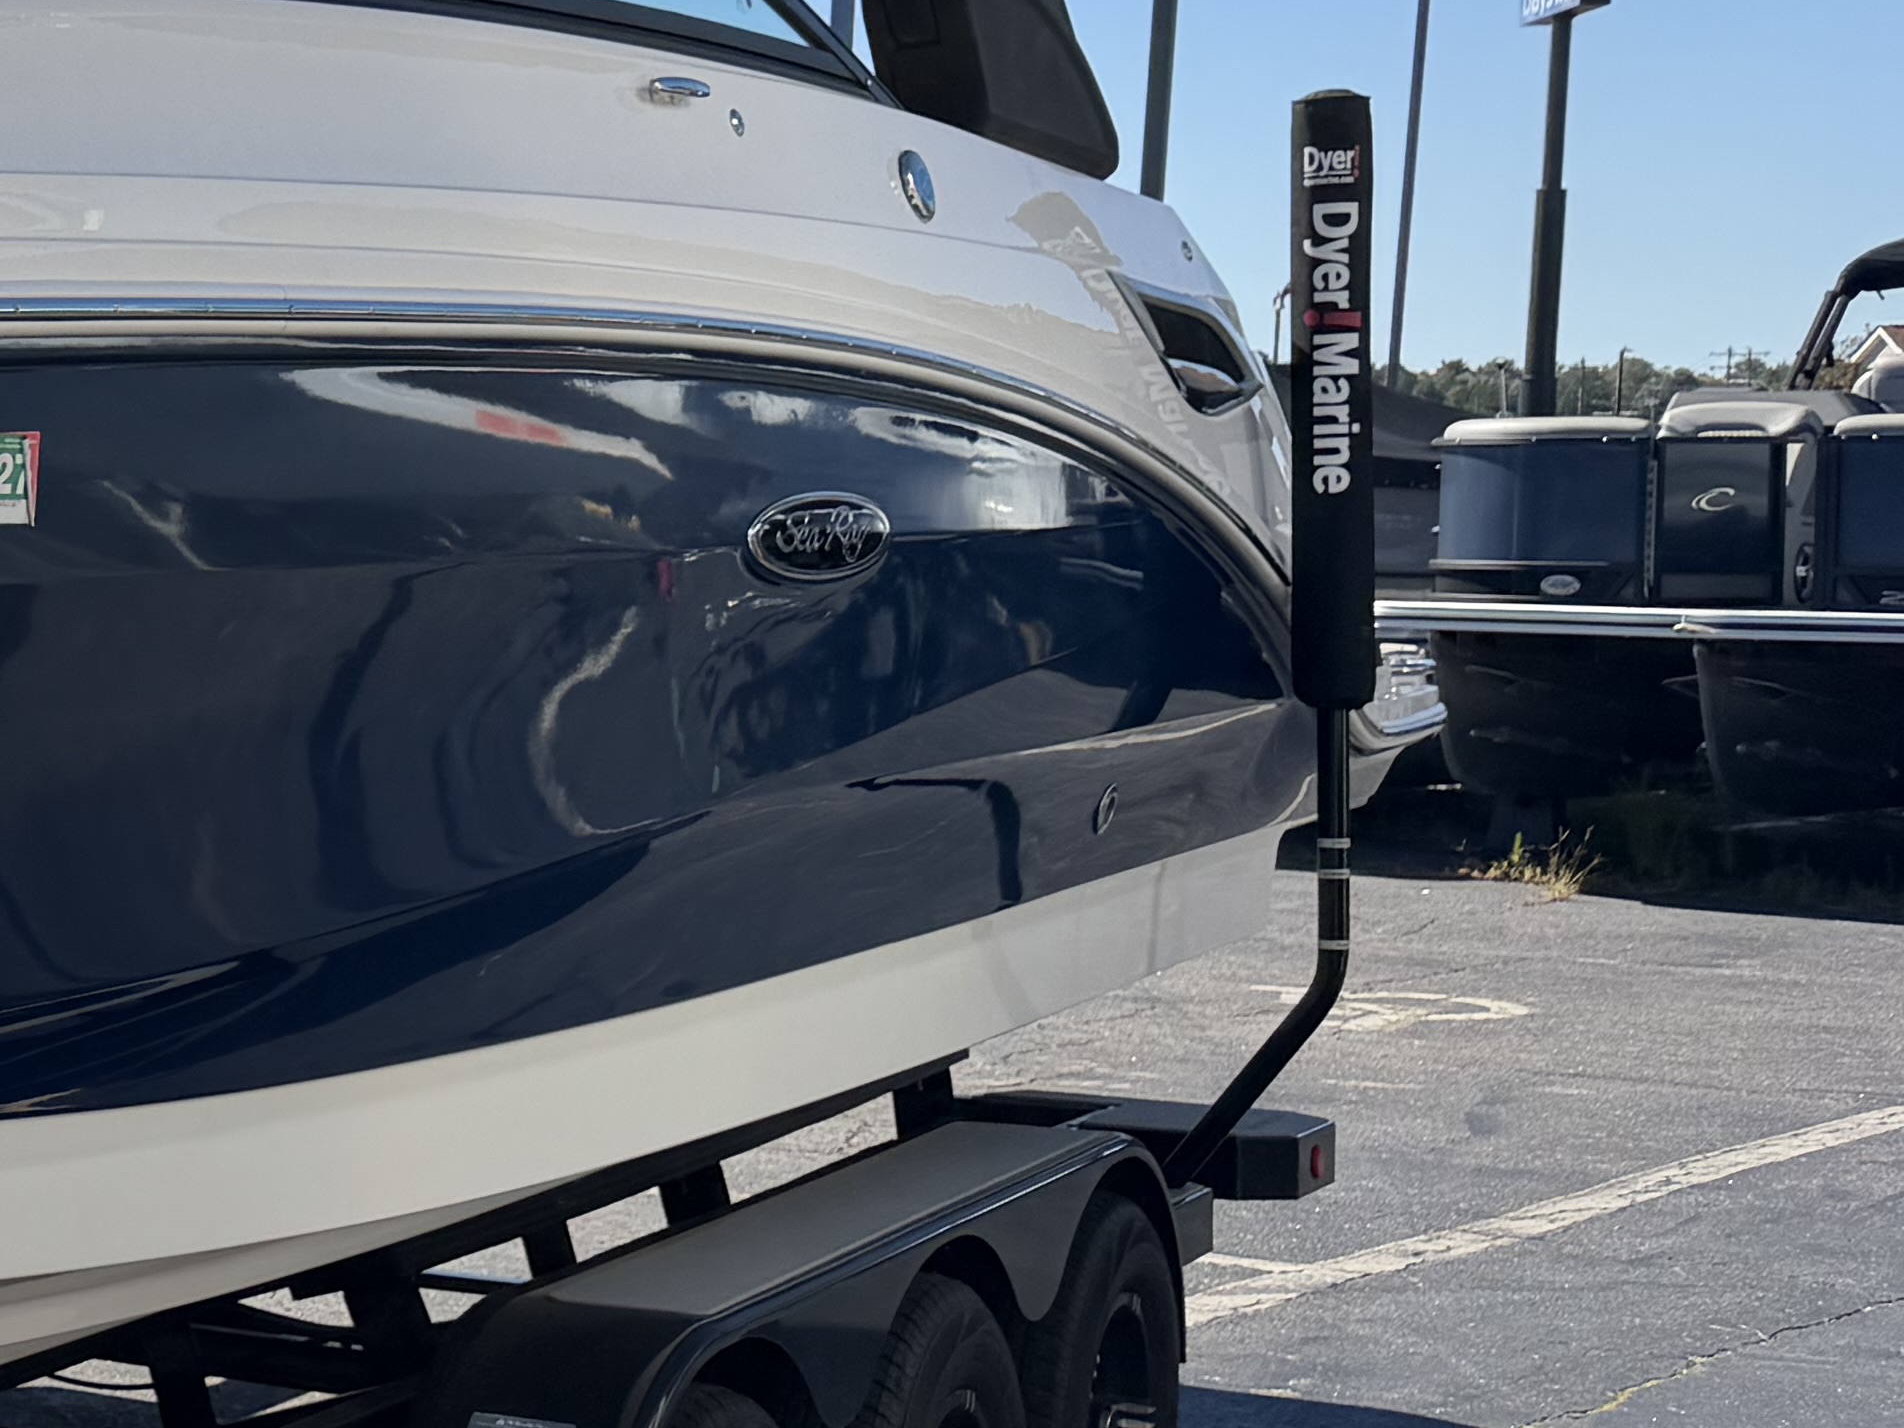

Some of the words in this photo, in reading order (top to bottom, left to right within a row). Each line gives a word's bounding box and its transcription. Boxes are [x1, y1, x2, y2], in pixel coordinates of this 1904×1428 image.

[1311, 332, 1361, 495] Marine
[775, 509, 824, 554] Sea
[824, 504, 872, 563] Ray
